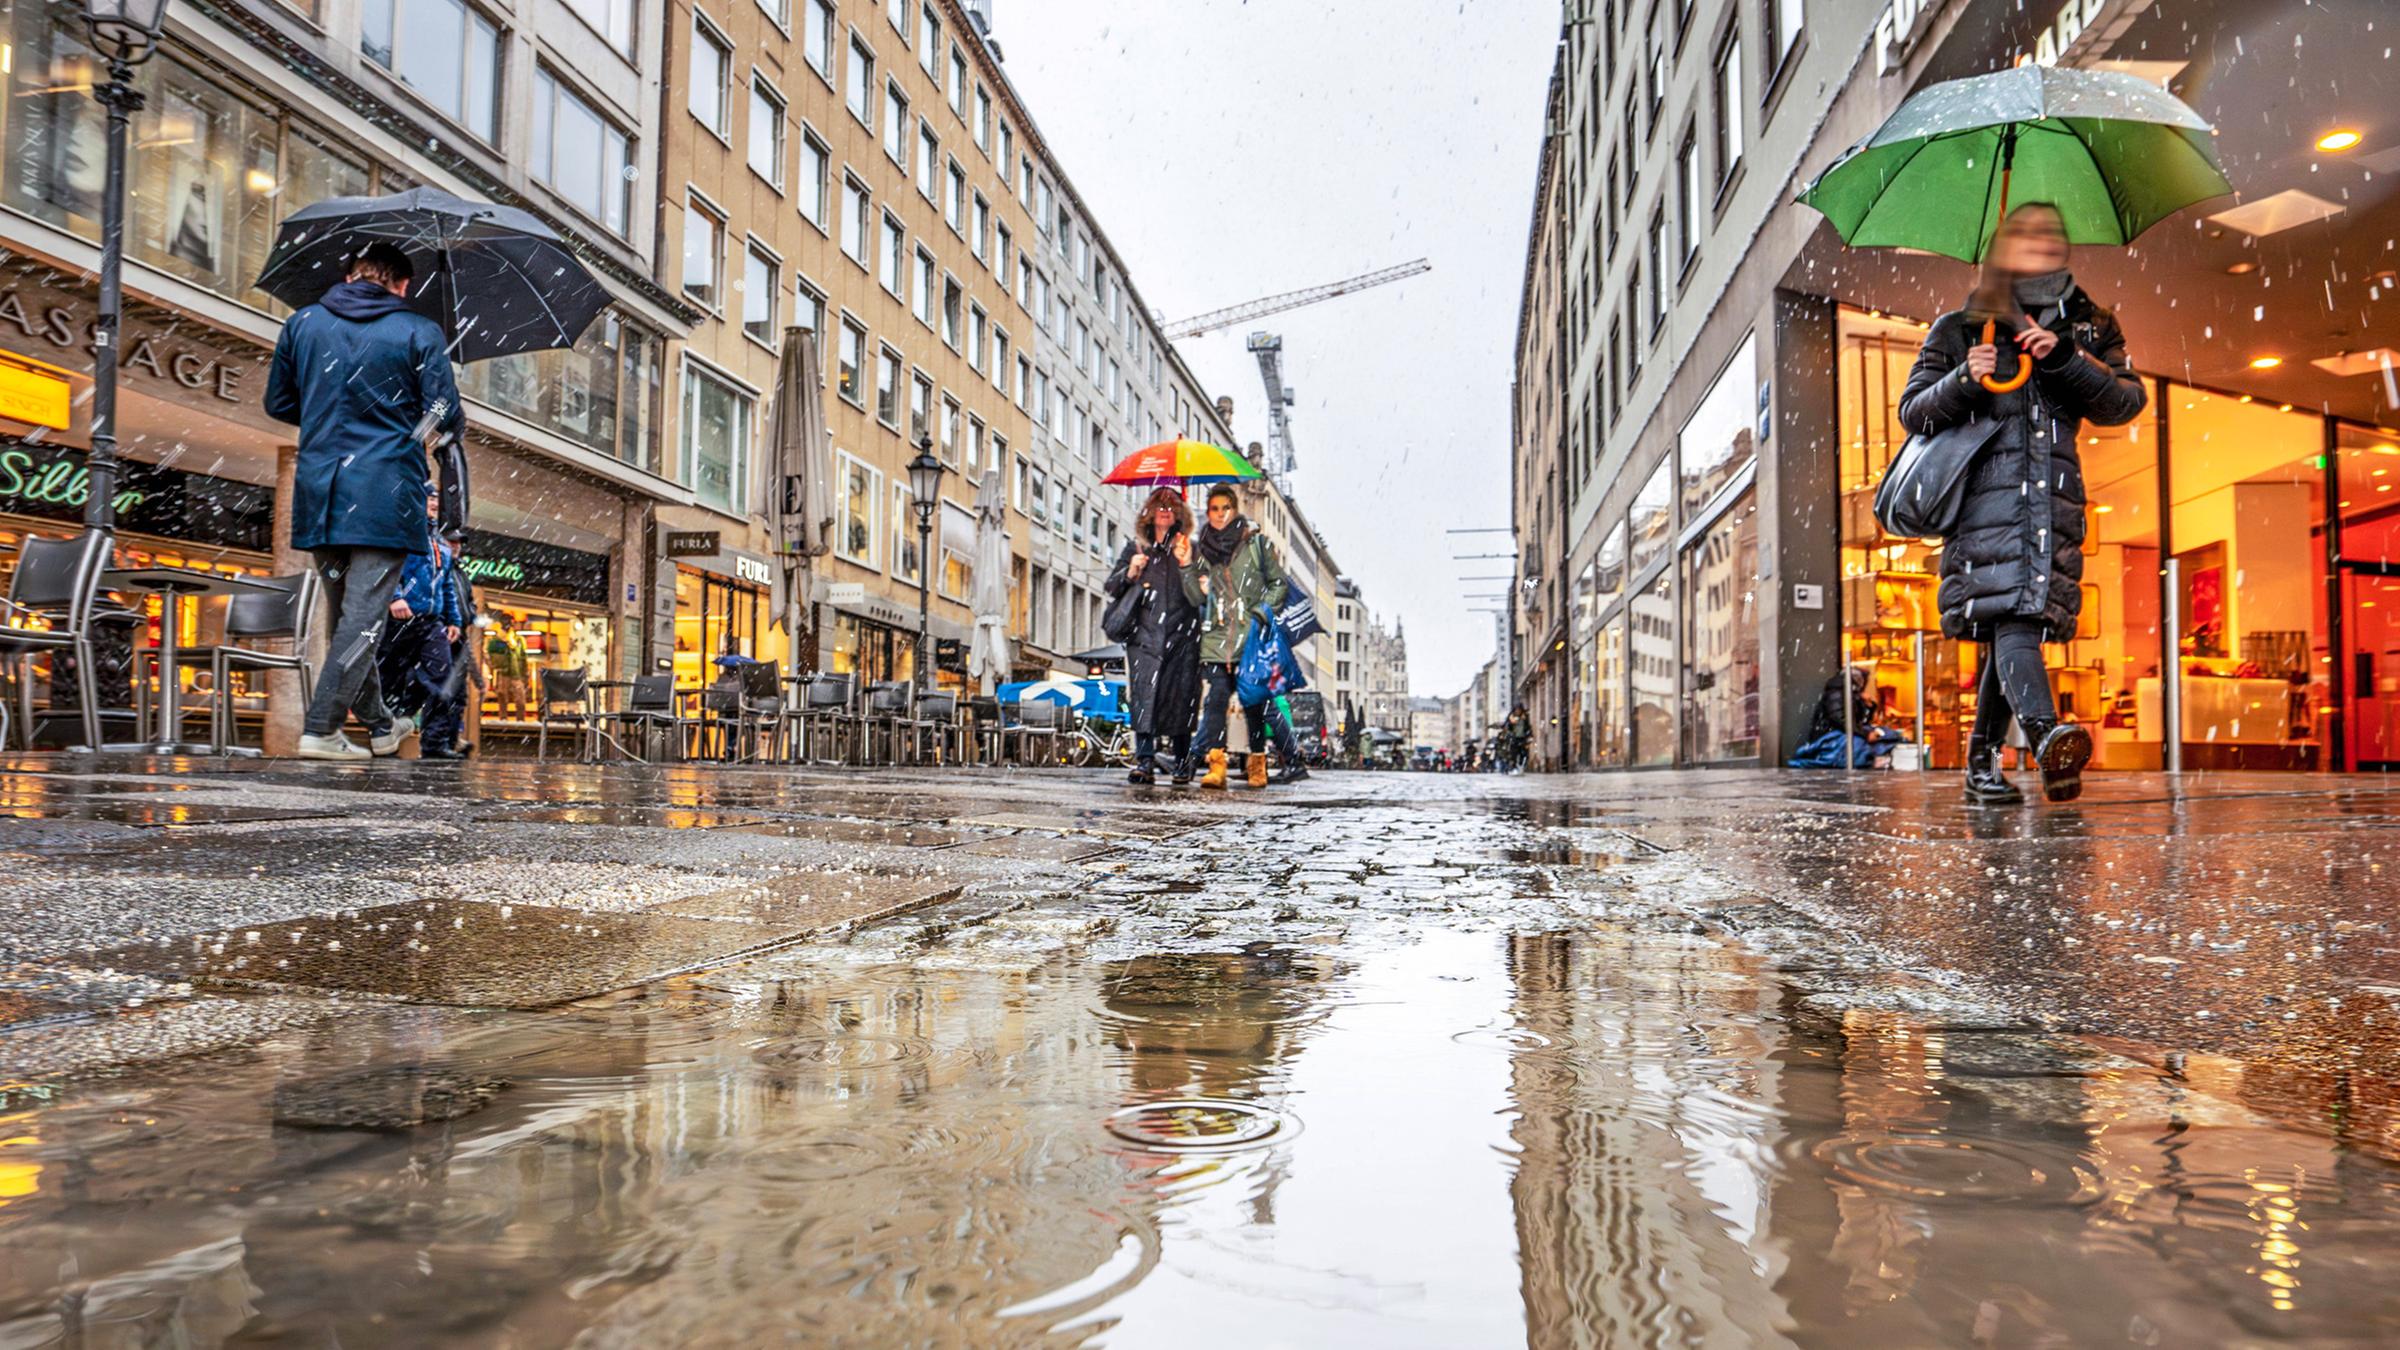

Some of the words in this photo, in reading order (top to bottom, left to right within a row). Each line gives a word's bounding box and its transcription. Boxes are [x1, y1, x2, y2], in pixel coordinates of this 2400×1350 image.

[0, 293, 243, 402] ASAGE
[0, 452, 145, 514] Silbr
[673, 538, 712, 549] FURLA
